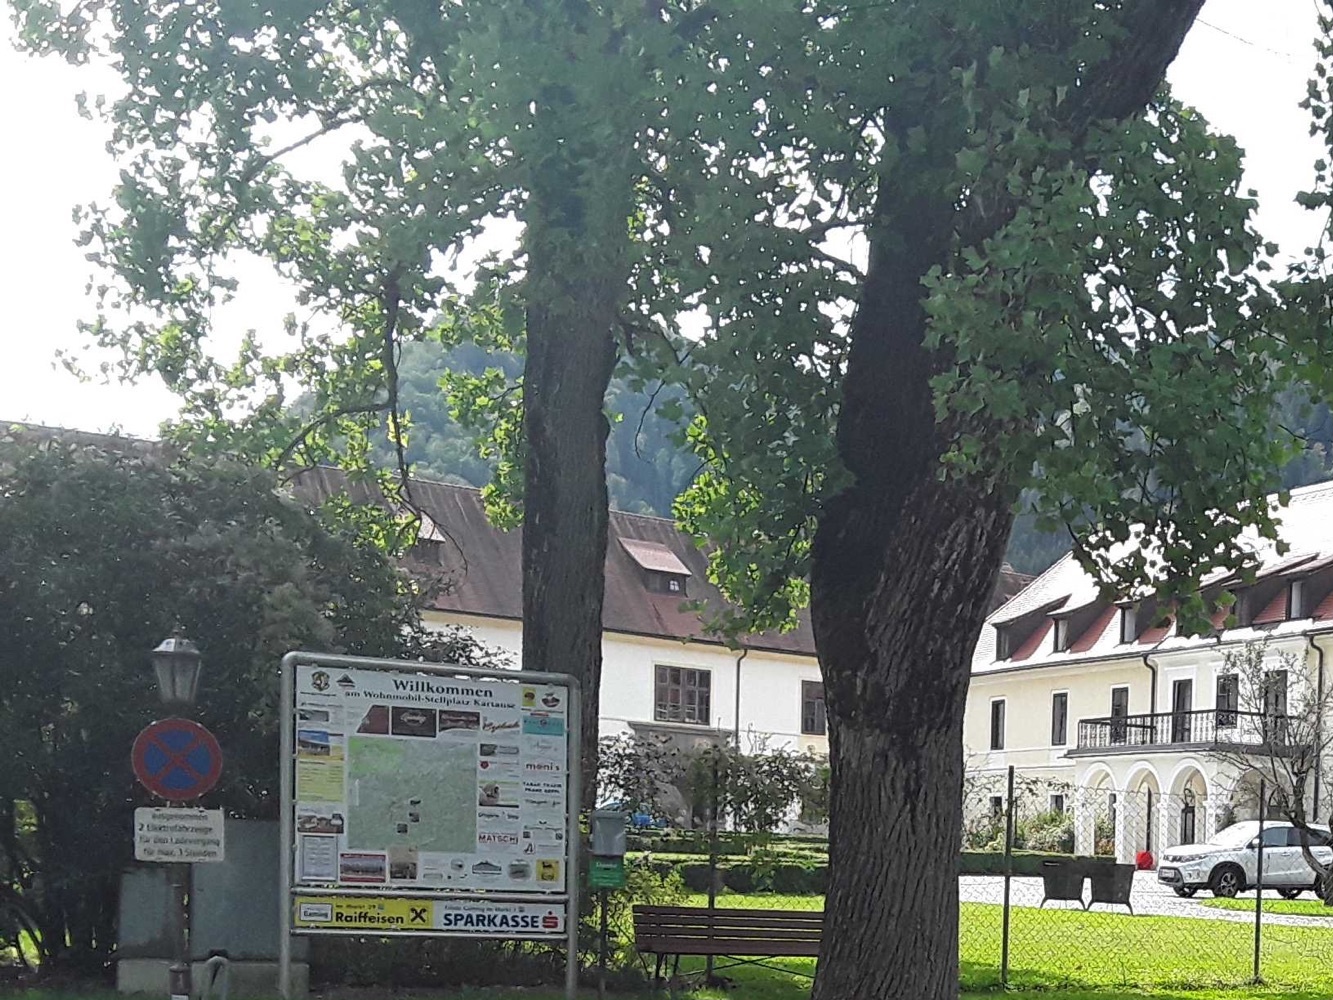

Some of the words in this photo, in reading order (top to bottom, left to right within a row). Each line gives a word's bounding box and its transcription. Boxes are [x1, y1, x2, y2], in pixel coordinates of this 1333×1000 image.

[392, 679, 494, 698] Willkommen
[473, 699, 516, 710] Kartause
[335, 911, 404, 925] Raiffeisen
[443, 912, 540, 928] SPARKASSE
